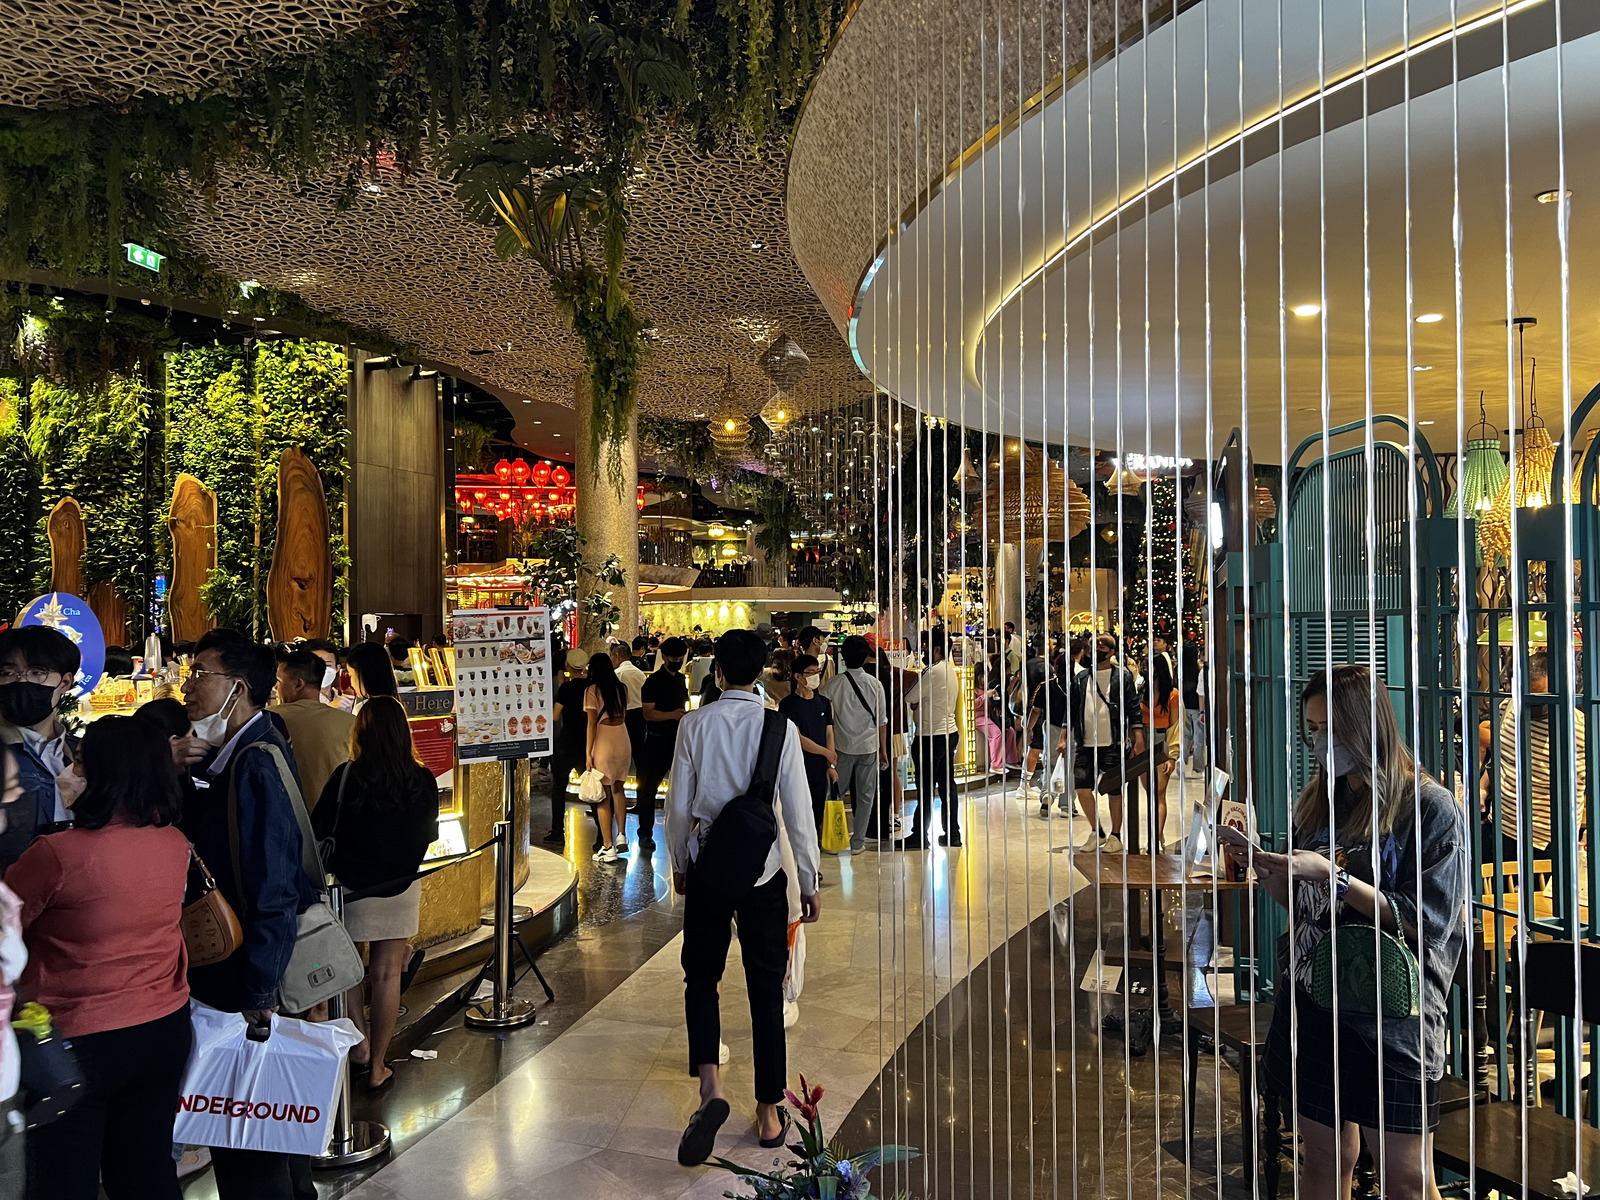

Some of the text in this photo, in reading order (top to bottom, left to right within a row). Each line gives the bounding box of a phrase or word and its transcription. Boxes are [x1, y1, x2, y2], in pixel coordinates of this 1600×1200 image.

[63, 608, 81, 616] Cha
[79, 674, 93, 686] Tea
[415, 695, 450, 711] Here
[176, 1094, 321, 1124] NDERGROUND
